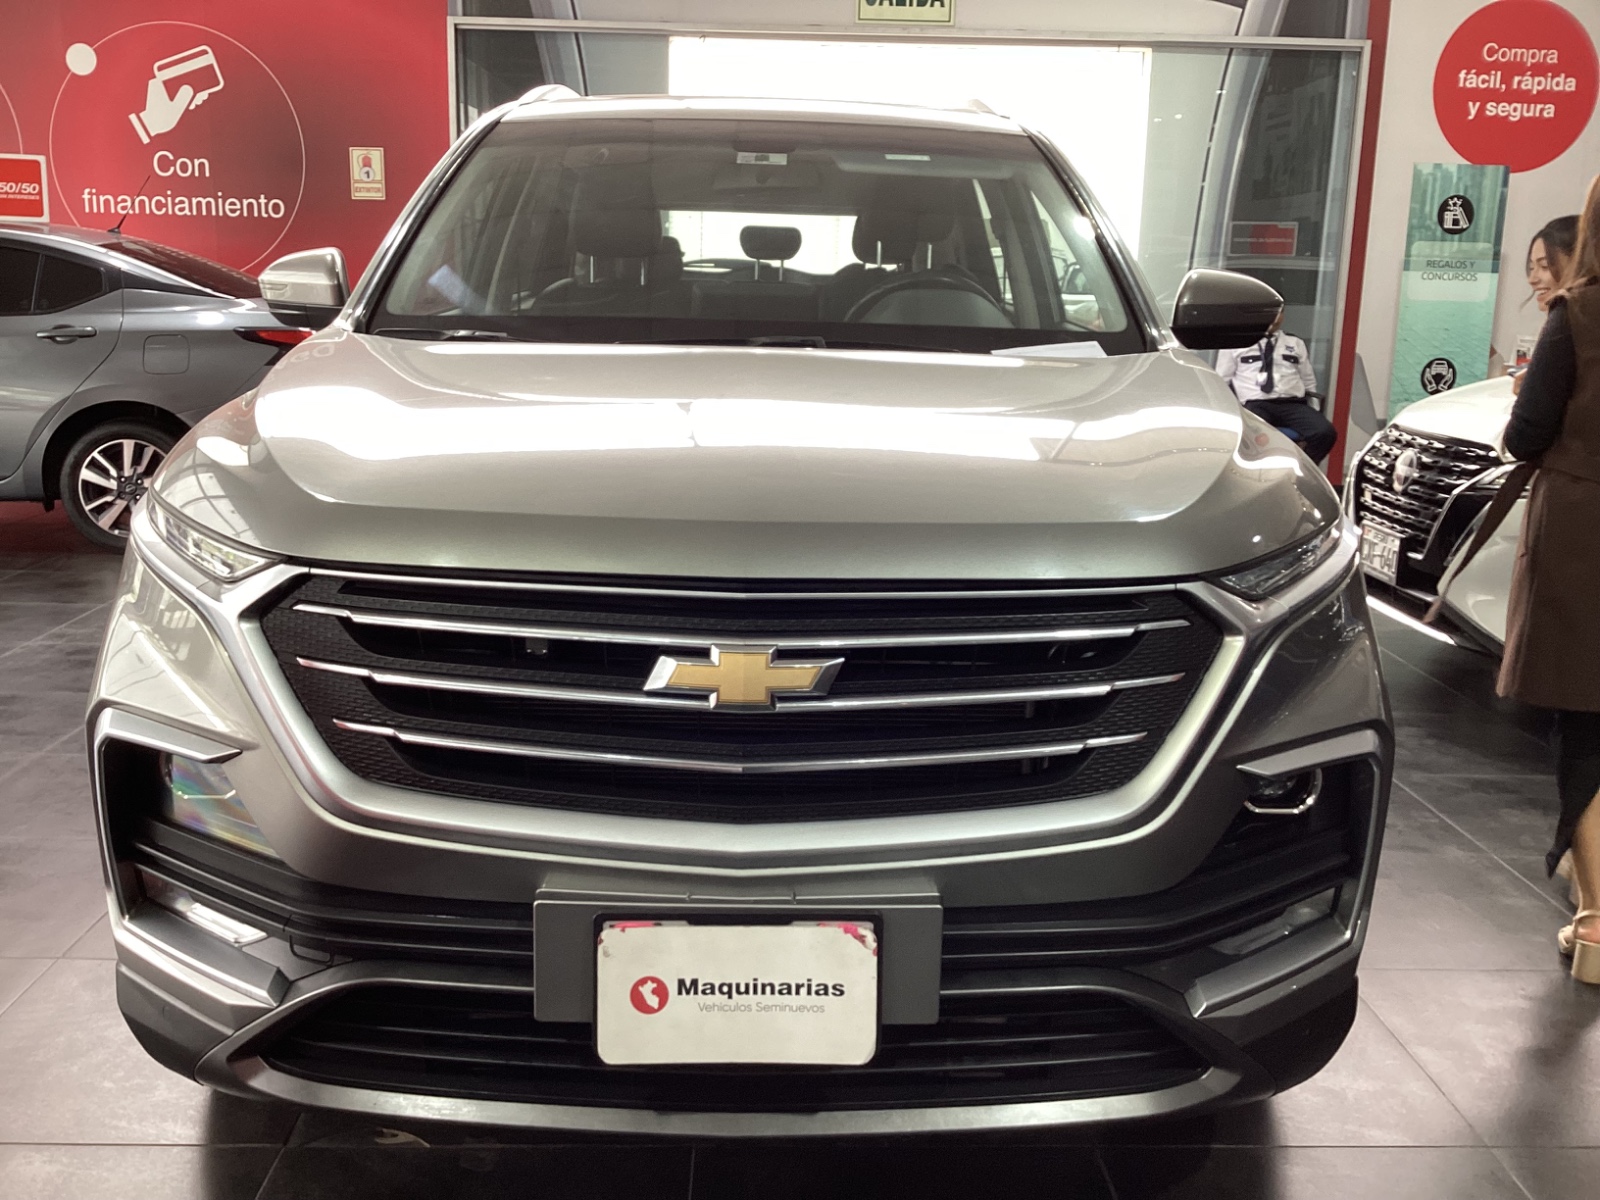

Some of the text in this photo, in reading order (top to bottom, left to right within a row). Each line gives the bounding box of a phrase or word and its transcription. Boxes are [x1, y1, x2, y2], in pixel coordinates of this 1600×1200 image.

[1483, 42, 1558, 67] Compra
[1458, 69, 1577, 94] fácil, rápida
[1467, 100, 1555, 121] y segura
[153, 150, 210, 178] Con
[364, 170, 370, 179] 1
[82, 188, 285, 219] financiamiento
[1426, 259, 1476, 269] REGALOS Y
[1421, 271, 1478, 282] CONCURSOS
[677, 978, 845, 1000] Maquinarias
[755, 1002, 825, 1013] Seminuevos
